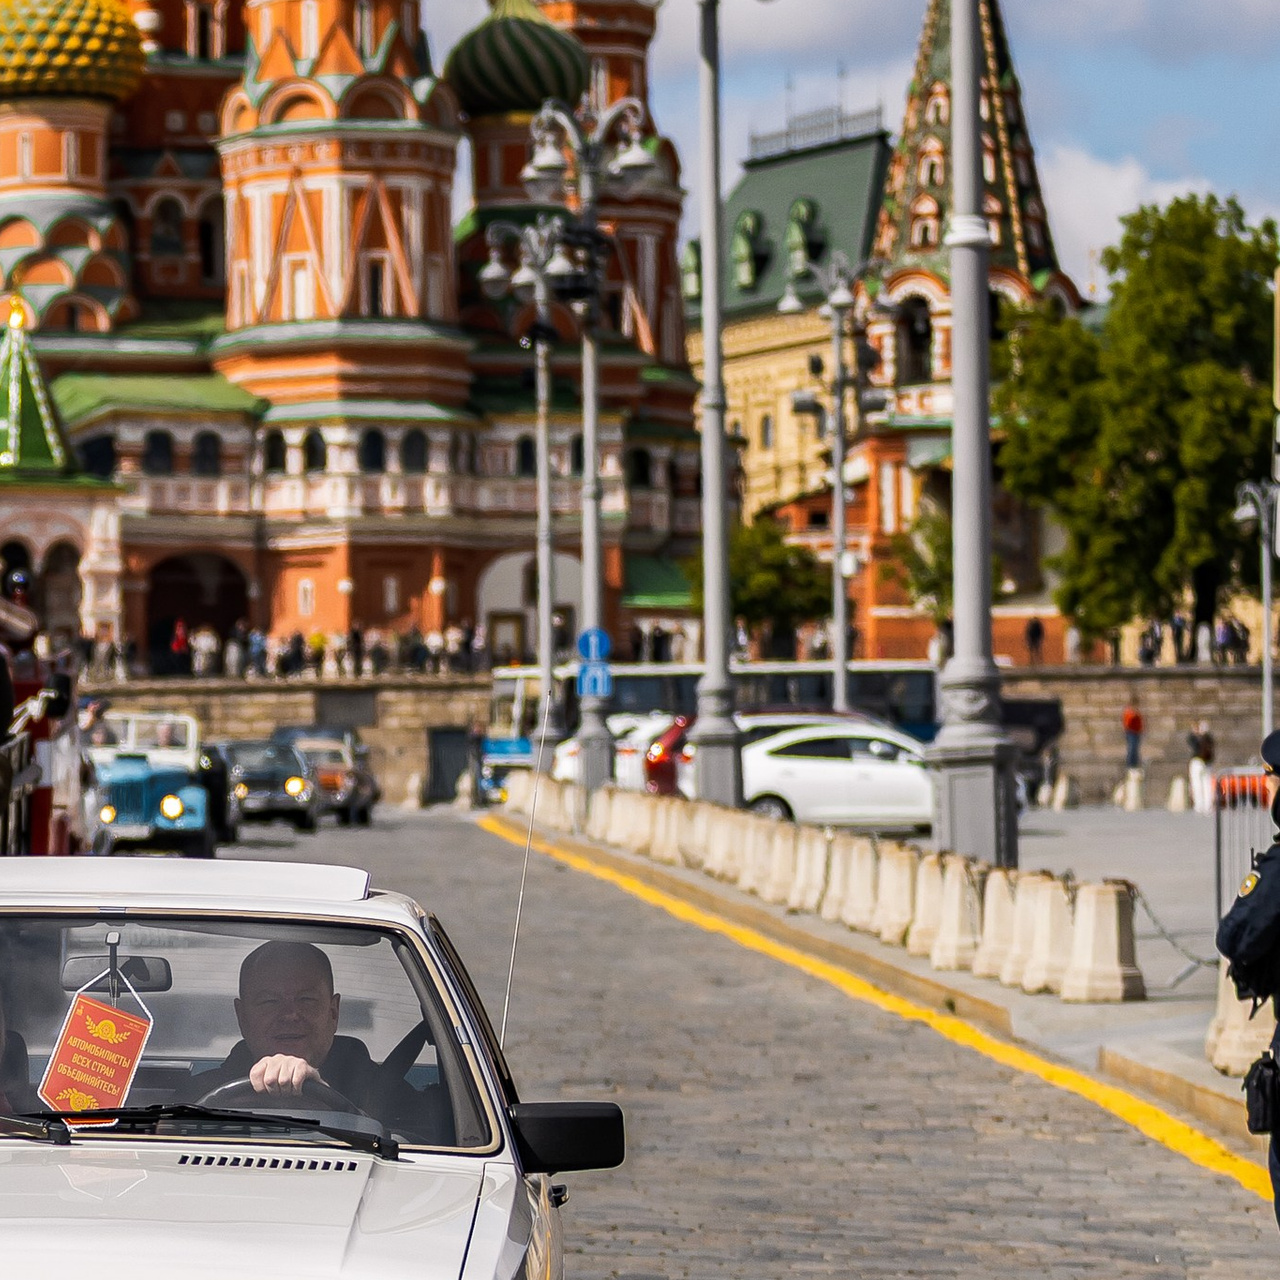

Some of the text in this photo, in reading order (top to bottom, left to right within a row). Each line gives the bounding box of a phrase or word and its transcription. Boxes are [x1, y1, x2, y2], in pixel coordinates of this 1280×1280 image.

[67, 1036, 131, 1069] АВТОМОБИЛИСТЫ
[72, 1053, 115, 1078] ВСЕХ СТРАН
[57, 1064, 120, 1096] ОБЪЕДИНЯЙТЕСЬ!
